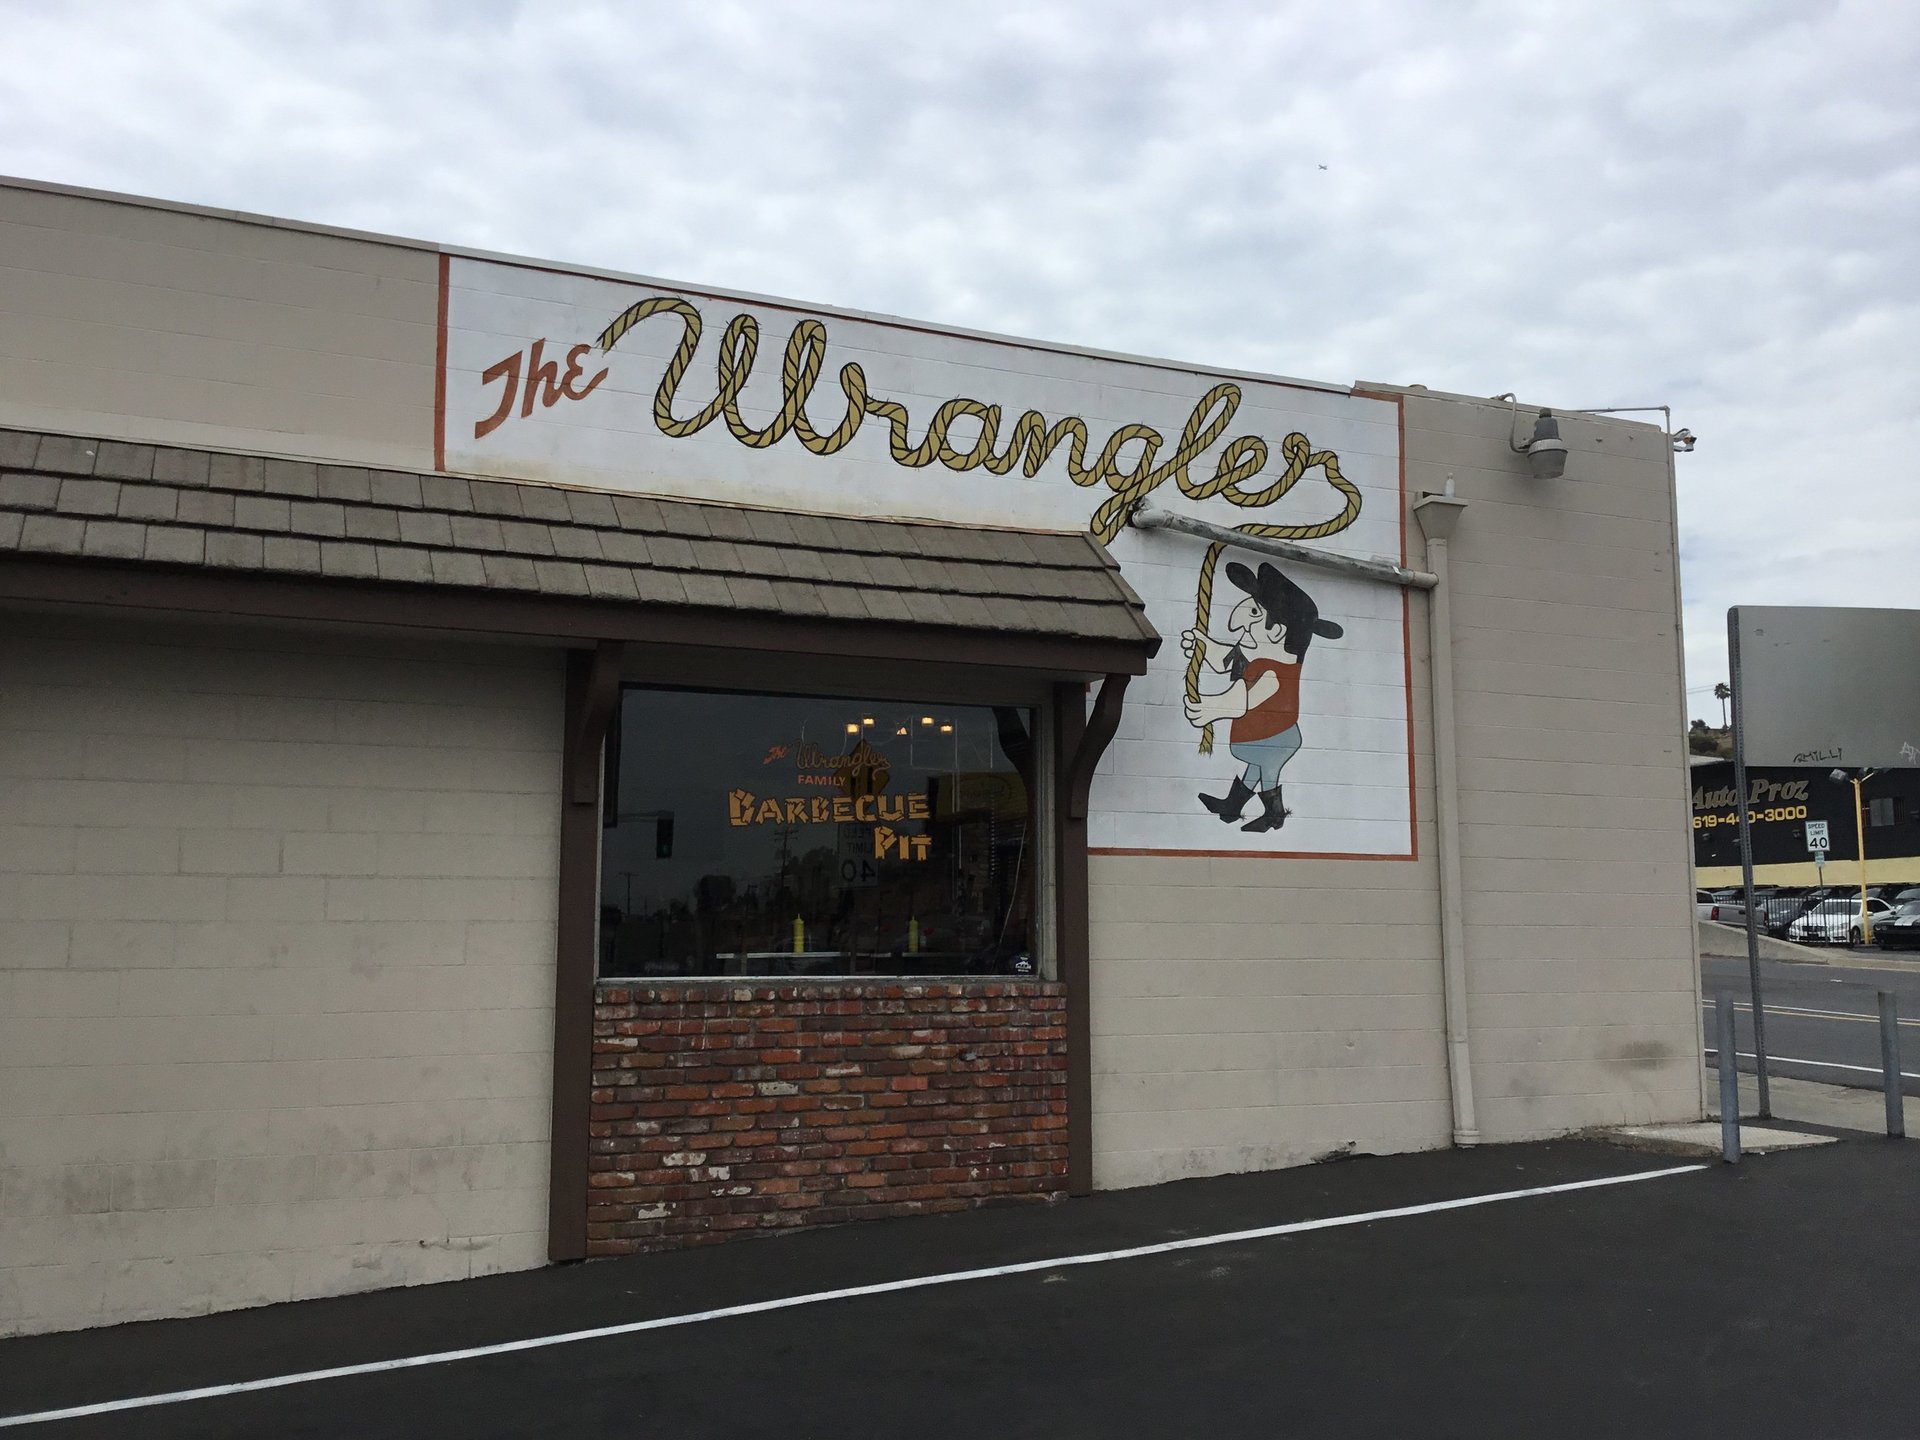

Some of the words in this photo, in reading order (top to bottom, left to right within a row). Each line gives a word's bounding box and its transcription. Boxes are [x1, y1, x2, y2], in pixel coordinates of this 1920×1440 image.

[474, 337, 608, 439] The
[597, 295, 1362, 546] Wrangler
[795, 740, 892, 778] Wrangler
[797, 774, 846, 786] FAMILY
[1692, 785, 1739, 809] Auto
[1747, 778, 1809, 804] Proz
[728, 787, 930, 827] BARBECUE
[873, 825, 933, 861] PIT
[1809, 837, 1828, 848] 40
